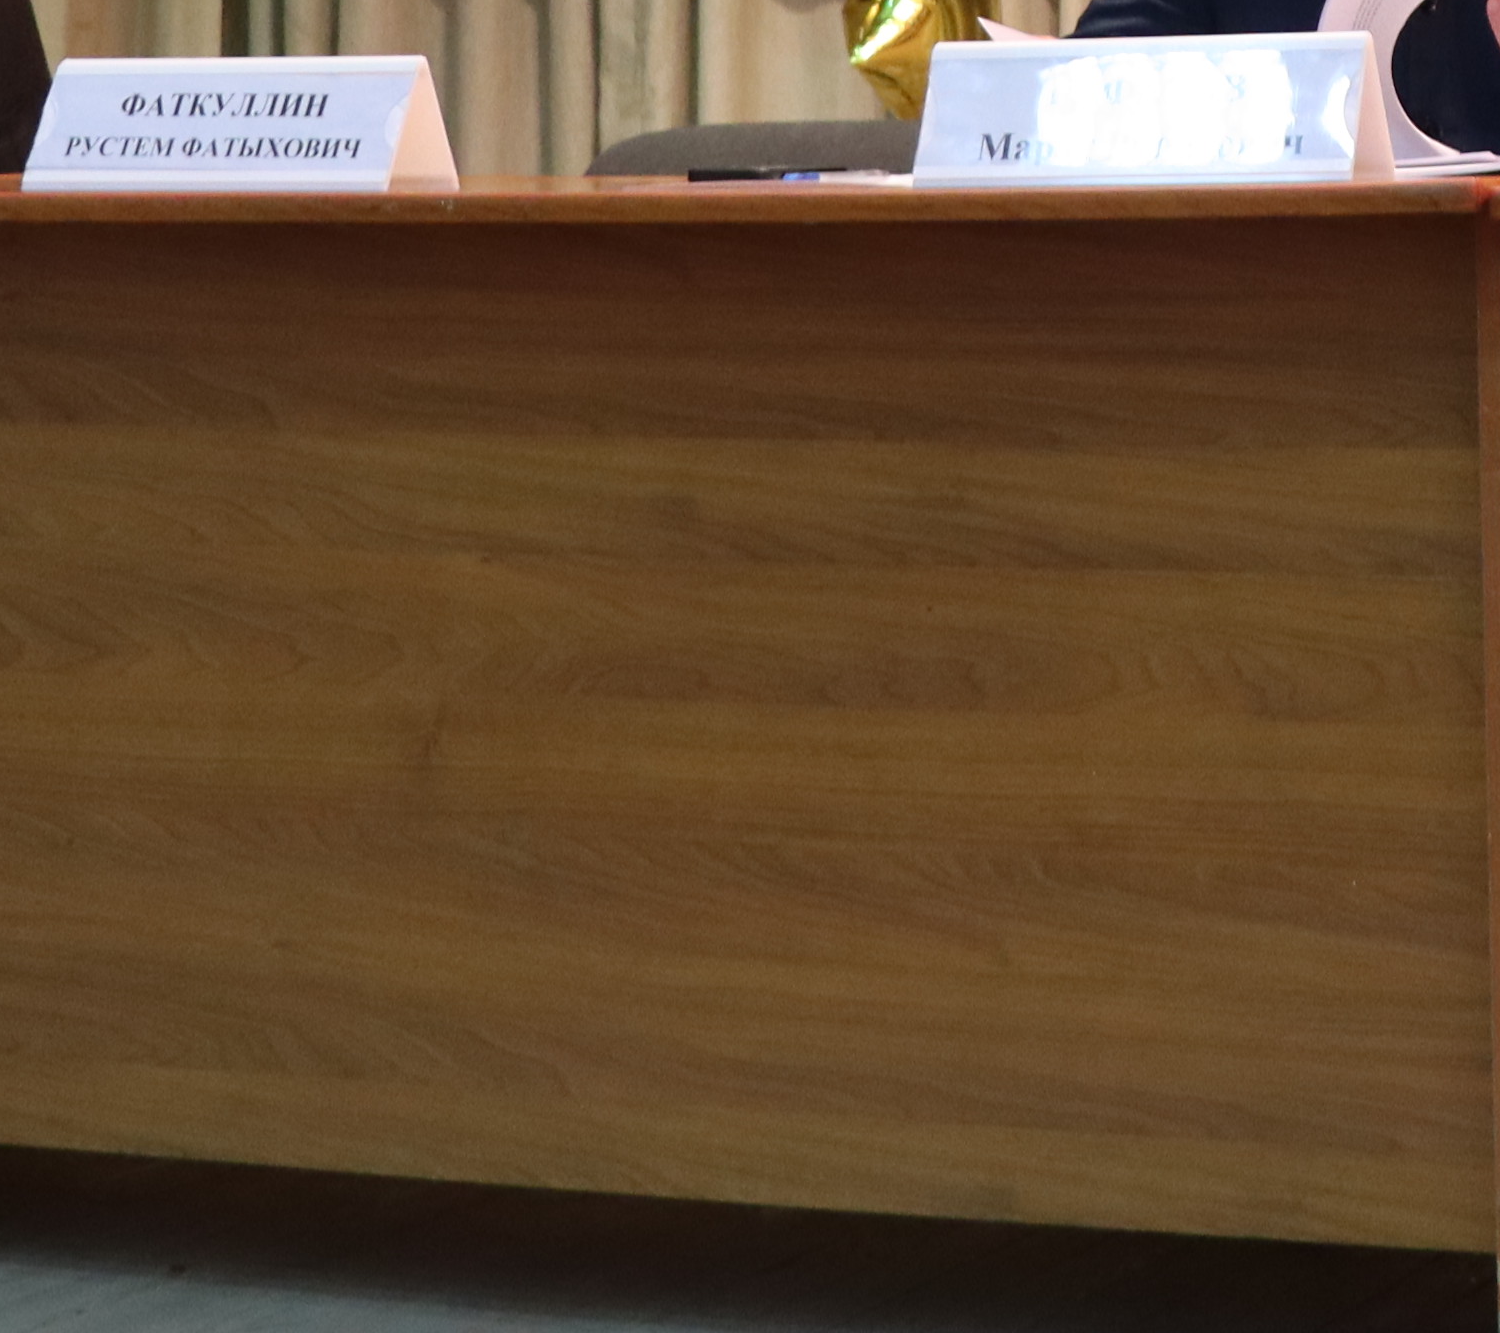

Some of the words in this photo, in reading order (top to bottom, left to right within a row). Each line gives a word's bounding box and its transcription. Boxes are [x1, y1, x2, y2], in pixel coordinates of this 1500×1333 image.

[121, 93, 329, 117] ФАТКУЛЛИН
[65, 137, 172, 158] РУСТЕМ
[182, 137, 362, 160] ФАТЫХОВИЧ
